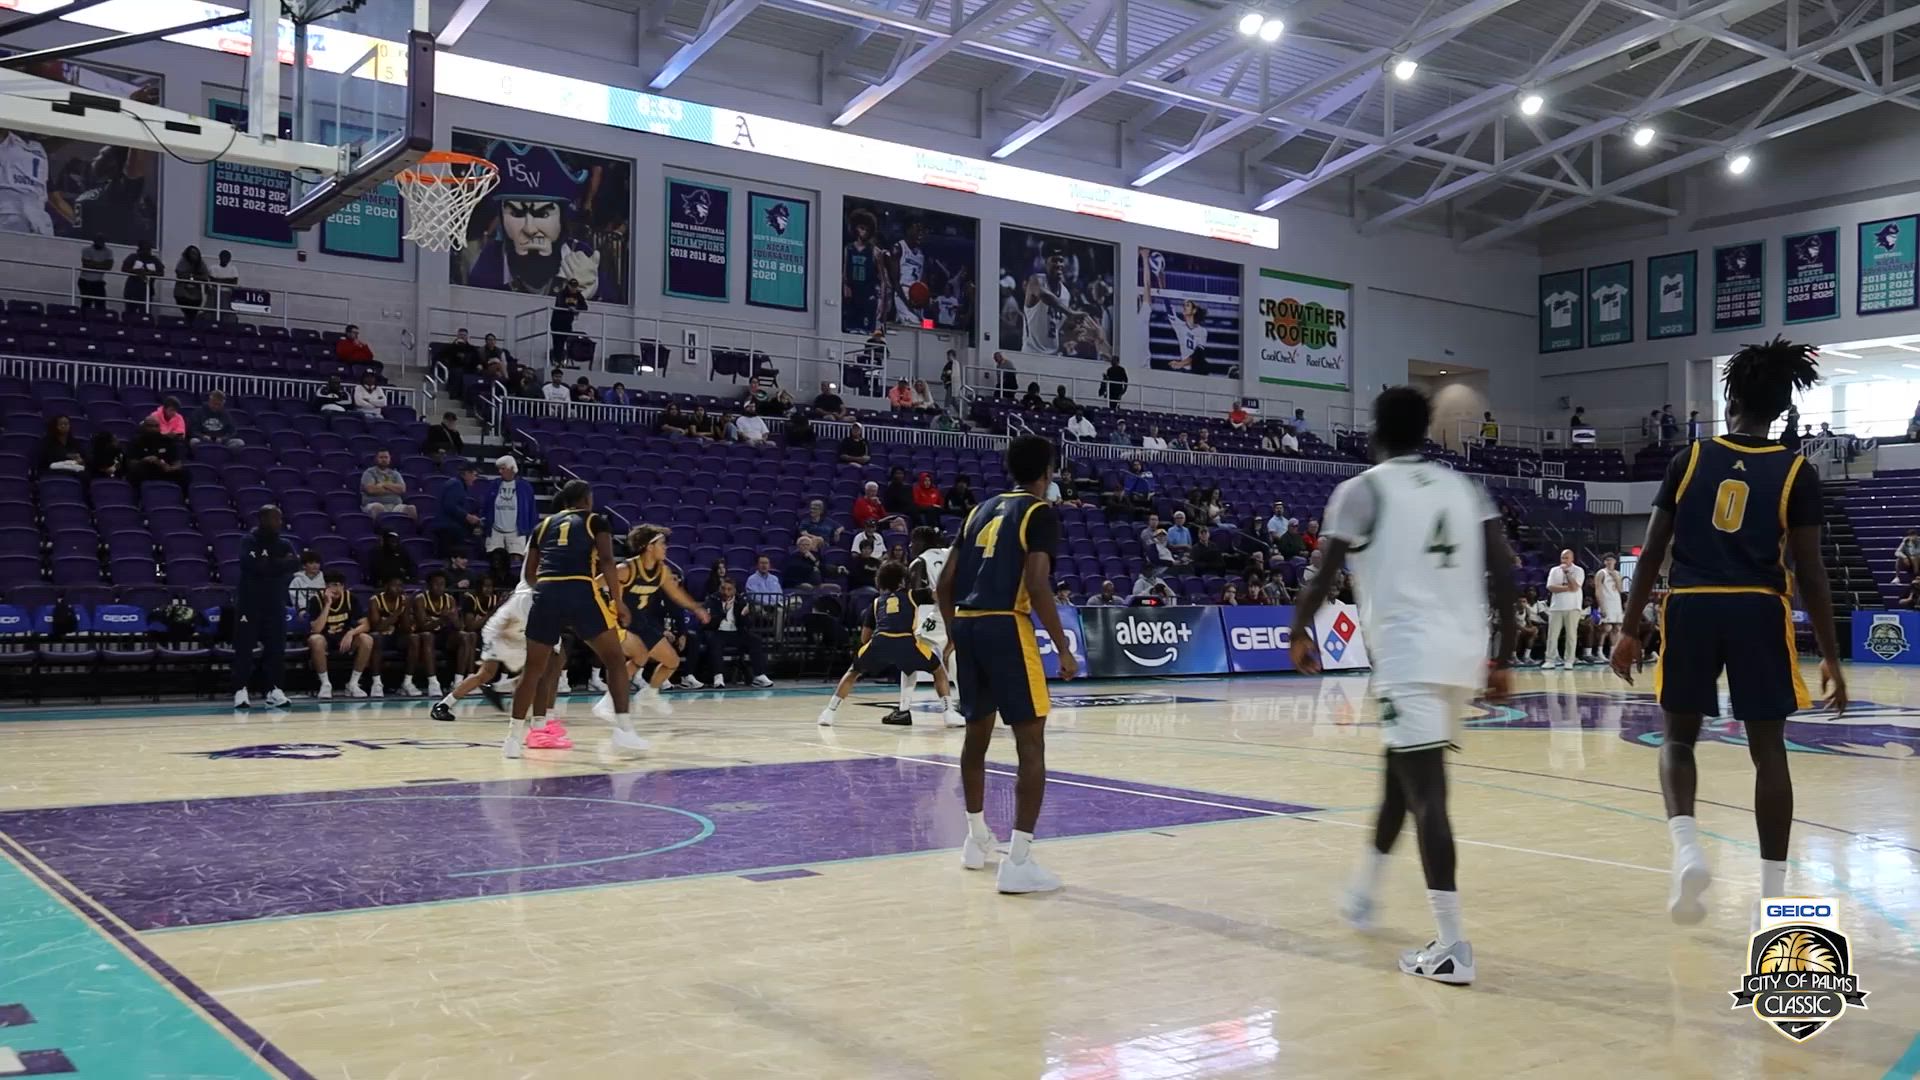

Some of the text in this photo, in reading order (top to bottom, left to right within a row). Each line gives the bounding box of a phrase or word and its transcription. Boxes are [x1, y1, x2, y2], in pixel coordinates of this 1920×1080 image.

[505, 158, 541, 188] FSW
[216, 183, 241, 195] 2018
[216, 195, 240, 208] 2021
[242, 199, 267, 212] 2022
[365, 205, 398, 218] 2020
[327, 213, 361, 225] 2025
[670, 236, 725, 253] CHAMPIONS
[752, 259, 777, 270] 2018
[752, 270, 777, 280] 2020
[1888, 270, 1915, 280] 2017
[1787, 284, 1810, 294] 2017
[1888, 279, 1914, 289] 2021
[245, 291, 264, 303] 116
[1787, 293, 1810, 303] 2023
[1259, 298, 1346, 330] CROWTHER
[1265, 321, 1337, 348] ROOFING
[1711, 478, 1750, 533] 0
[557, 521, 571, 546] 1
[974, 514, 1005, 559] 4
[1423, 507, 1461, 569] 4
[1115, 615, 1192, 645] alexa+
[1230, 626, 1300, 650] GEIC
